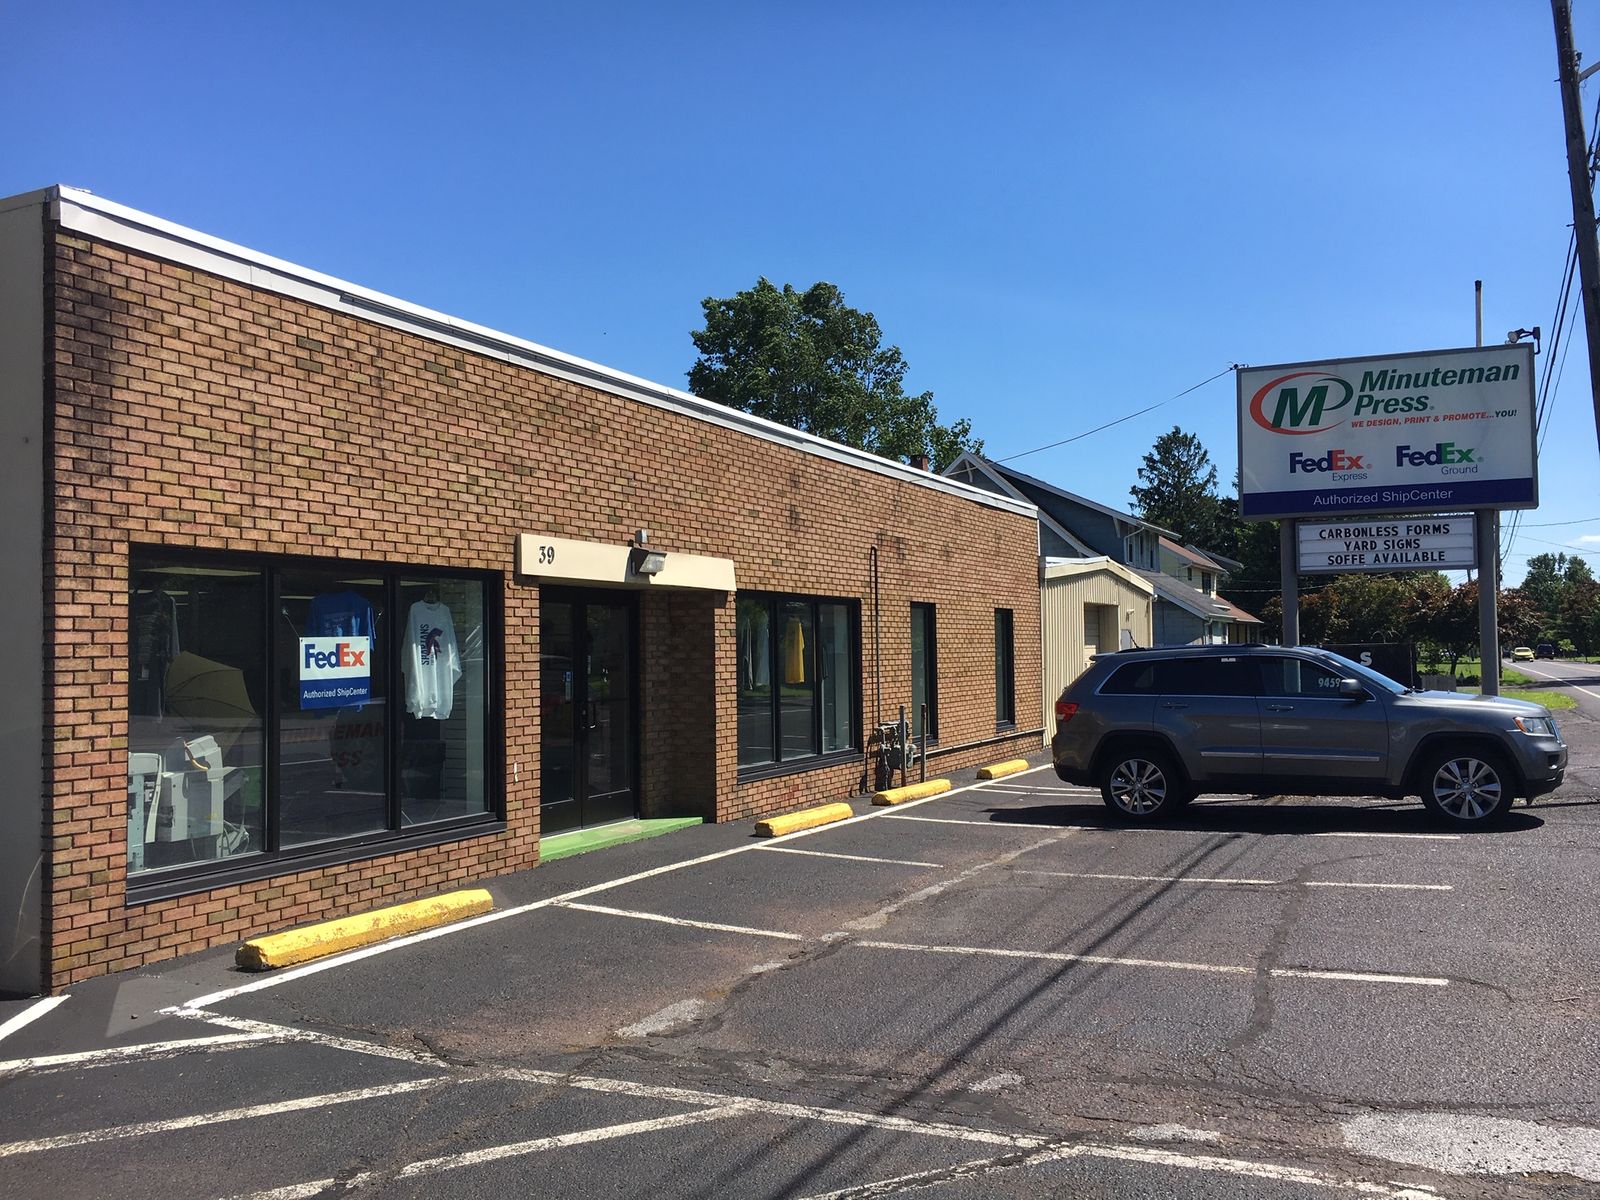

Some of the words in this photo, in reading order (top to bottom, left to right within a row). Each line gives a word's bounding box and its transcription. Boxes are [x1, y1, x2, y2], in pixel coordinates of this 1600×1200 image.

[1359, 364, 1520, 392] Minuteman
[1351, 420, 1364, 429] WE
[1366, 418, 1402, 427] DESIGN,
[1404, 415, 1431, 424] PRINT
[1289, 449, 1364, 474] FedEx
[1396, 442, 1475, 467] FedEx
[1332, 472, 1368, 482] Express
[1441, 464, 1478, 475] Ground
[1313, 492, 1378, 505] Authorized
[1382, 489, 1453, 503] ShipCenter
[1319, 525, 1399, 539] CARBONLESS
[1406, 523, 1450, 535] FORMS
[1344, 540, 1377, 551] YARD
[1384, 538, 1421, 550] SIGNS
[538, 545, 555, 565] 39
[1327, 553, 1366, 566] SOFFE
[1373, 551, 1446, 564] AVAILABLE
[304, 642, 365, 669] FedEx
[303, 689, 336, 699] Authorized
[336, 687, 368, 698] ShipCenter
